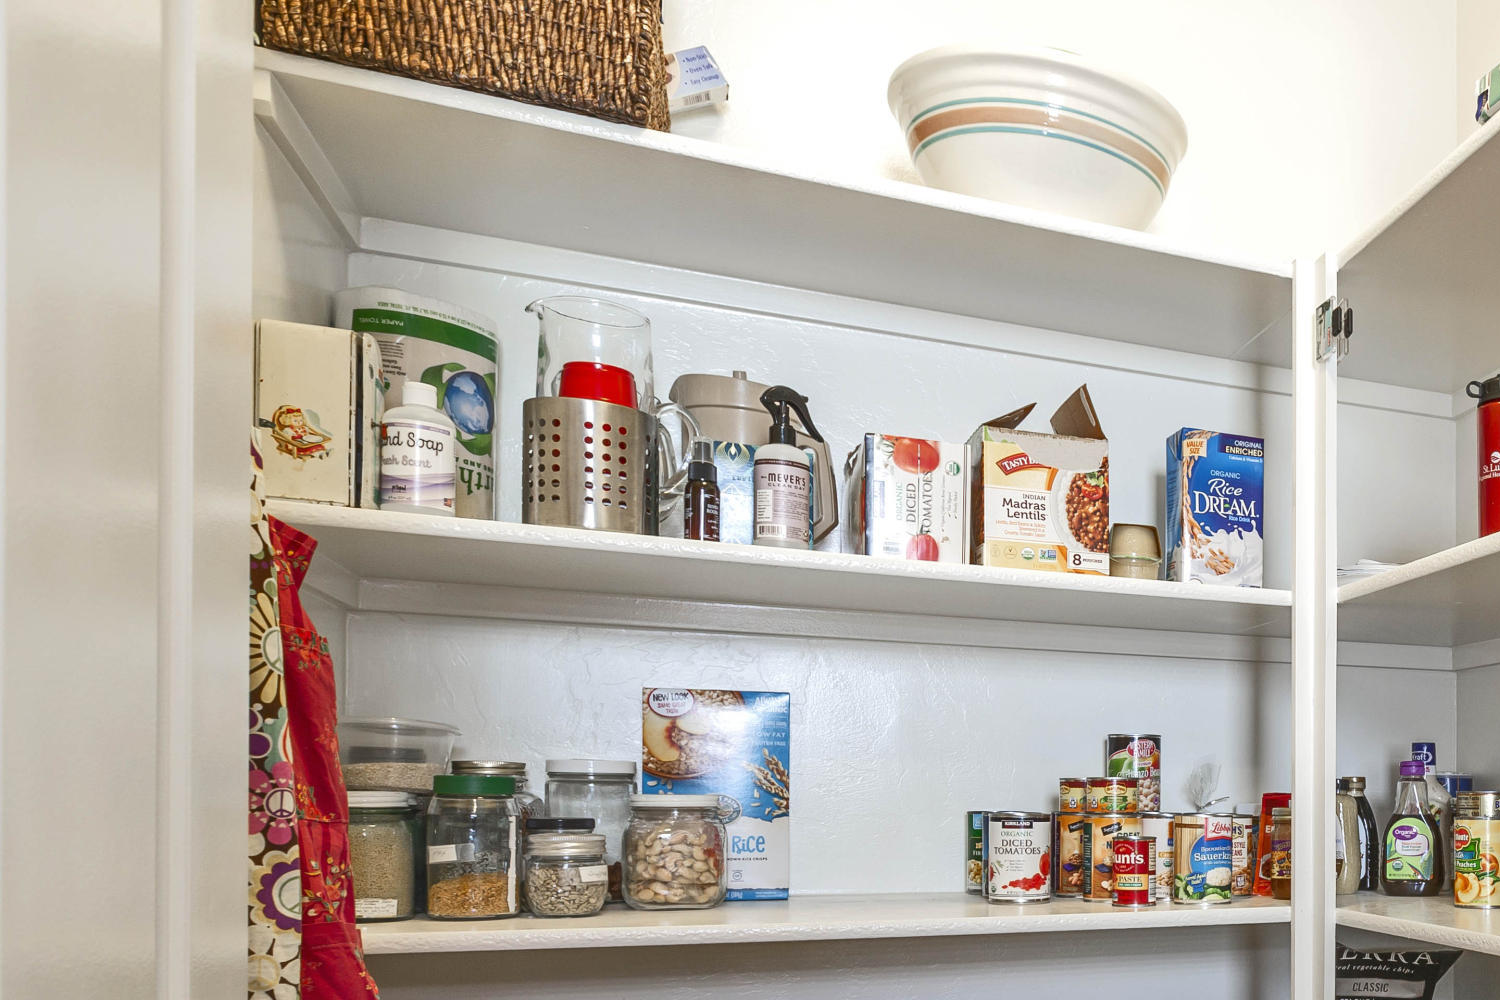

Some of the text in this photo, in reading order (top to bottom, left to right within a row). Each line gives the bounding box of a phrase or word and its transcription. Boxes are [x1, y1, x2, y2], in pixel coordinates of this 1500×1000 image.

[406, 431, 444, 456] Soap
[1234, 440, 1262, 449] ORIGINAL
[1225, 446, 1263, 457] ENRICHED
[401, 455, 432, 468] Scent
[1002, 453, 1029, 471] TASTY
[767, 472, 806, 487] MEYER'S
[1211, 470, 1240, 479] ORGANIC
[1208, 478, 1243, 496] Rice
[906, 483, 917, 523] DICED
[921, 470, 934, 533] TOMATOES
[1022, 493, 1046, 501] INDIAN
[1002, 498, 1046, 511] Madras
[1193, 491, 1257, 517] DREAM
[1006, 508, 1046, 521] Lentils
[671, 692, 688, 701] LOOK
[1209, 822, 1231, 834] Libby's
[994, 847, 1041, 855] TOMATOES
[1352, 983, 1390, 993] CLASSIC
